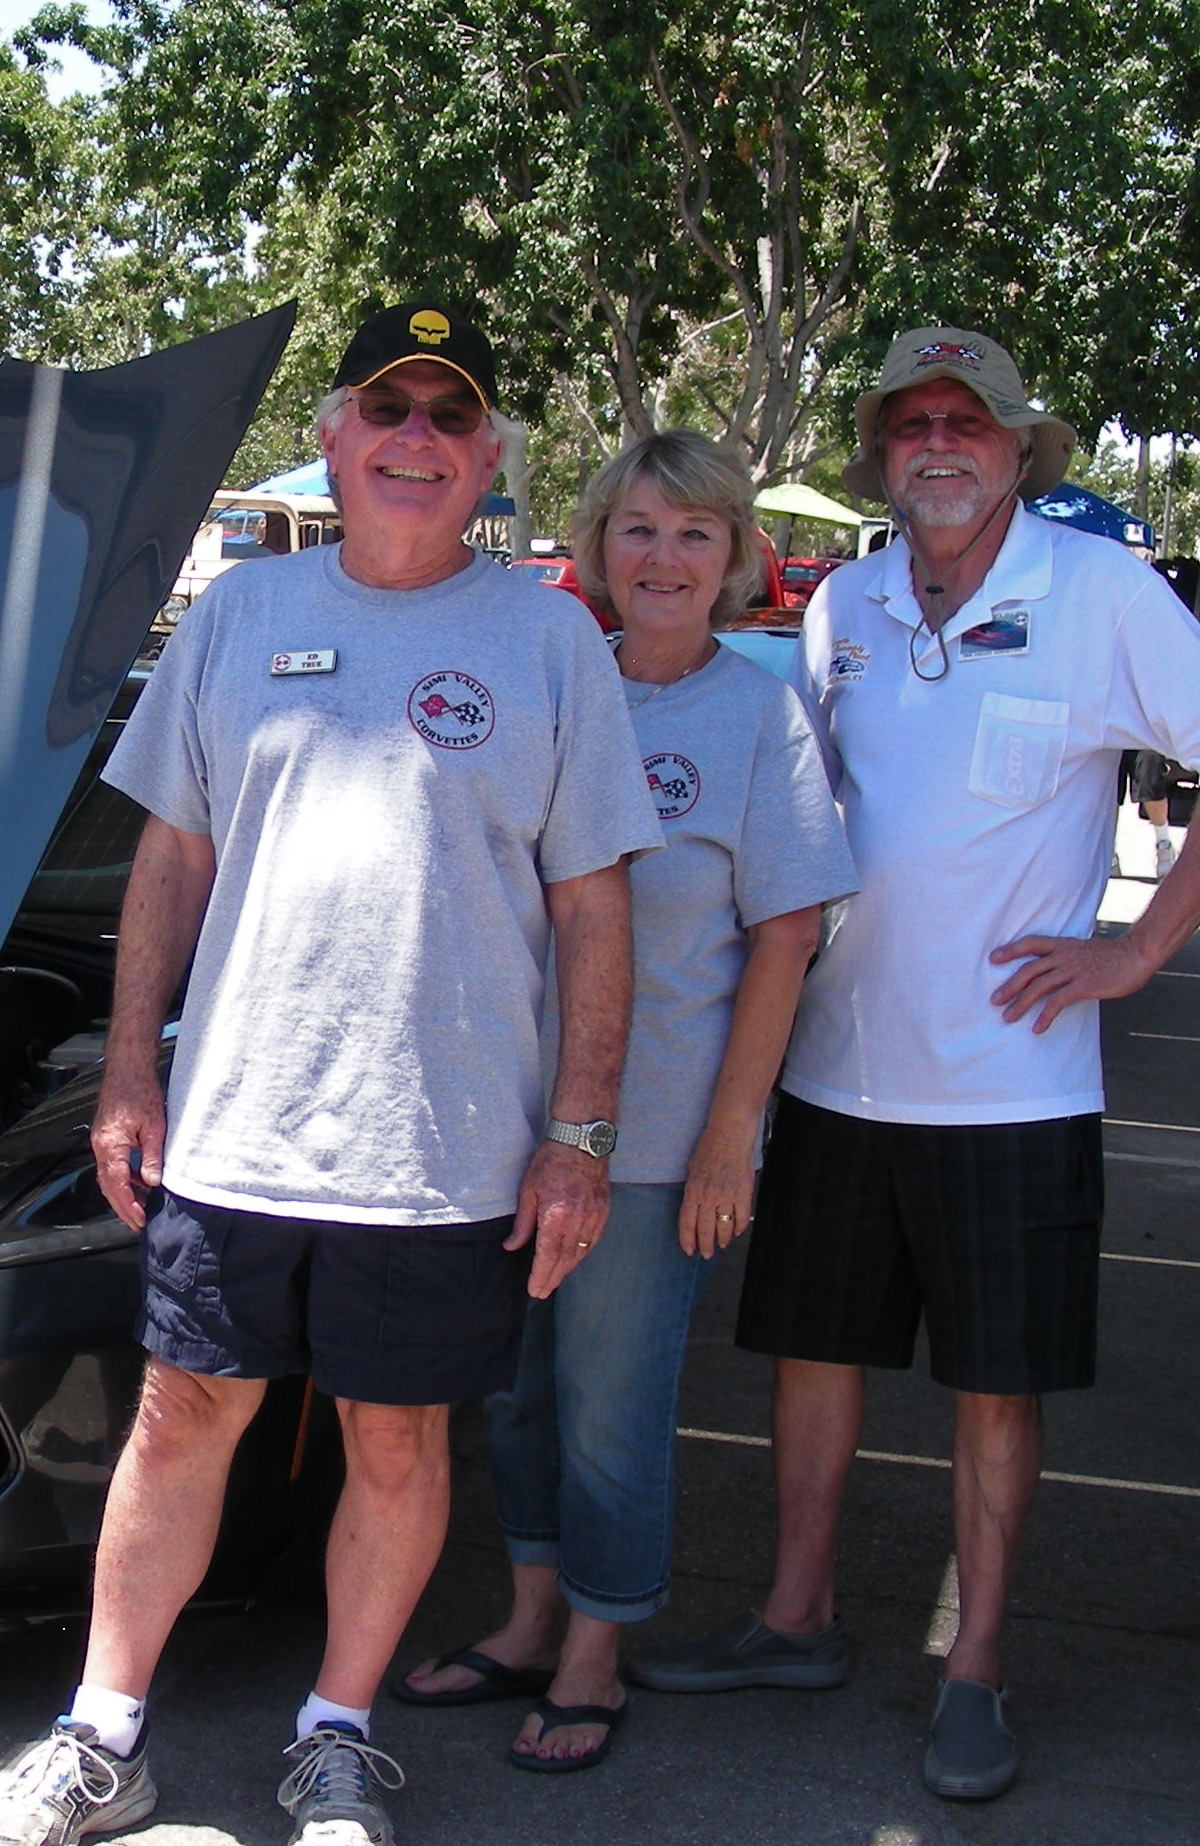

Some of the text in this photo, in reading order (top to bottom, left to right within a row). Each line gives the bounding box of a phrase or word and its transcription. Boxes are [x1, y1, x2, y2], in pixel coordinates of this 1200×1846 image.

[422, 675, 490, 707] SIMI VALLEY
[417, 718, 478, 745] CORVETTES
[673, 756, 697, 785] VALLEY
